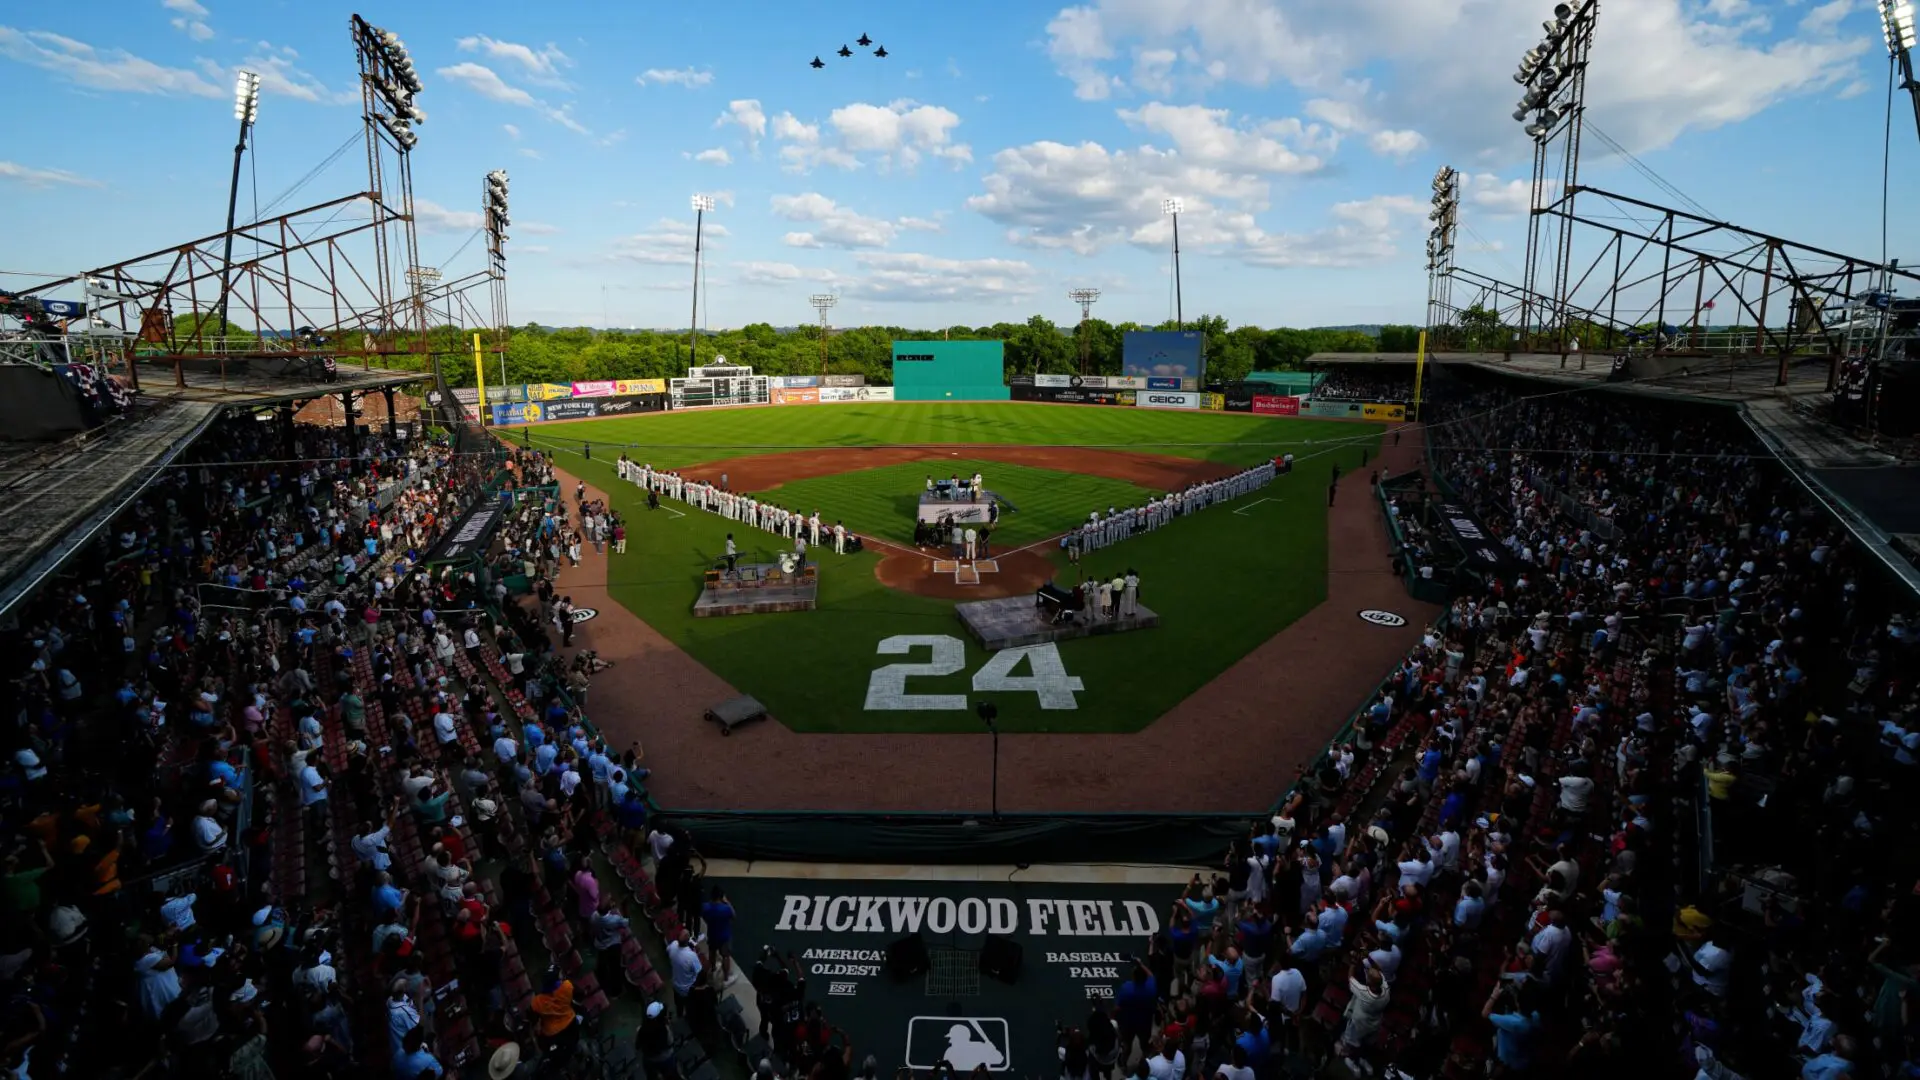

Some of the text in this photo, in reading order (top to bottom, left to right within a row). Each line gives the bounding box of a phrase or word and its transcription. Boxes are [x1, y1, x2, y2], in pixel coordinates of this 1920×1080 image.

[1149, 395, 1185, 404] GEICO
[547, 404, 563, 412] NEW
[563, 402, 581, 410] YORK
[1256, 402, 1296, 410] Budweiser
[863, 634, 1085, 710] 24
[775, 895, 1160, 936] RICKWOOD FIELD
[802, 948, 888, 961] AMERICA'
[811, 963, 881, 977] OLDEST
[1069, 967, 1120, 978] PARK
[828, 984, 857, 995] EST.
[1085, 987, 1115, 998] 1910
